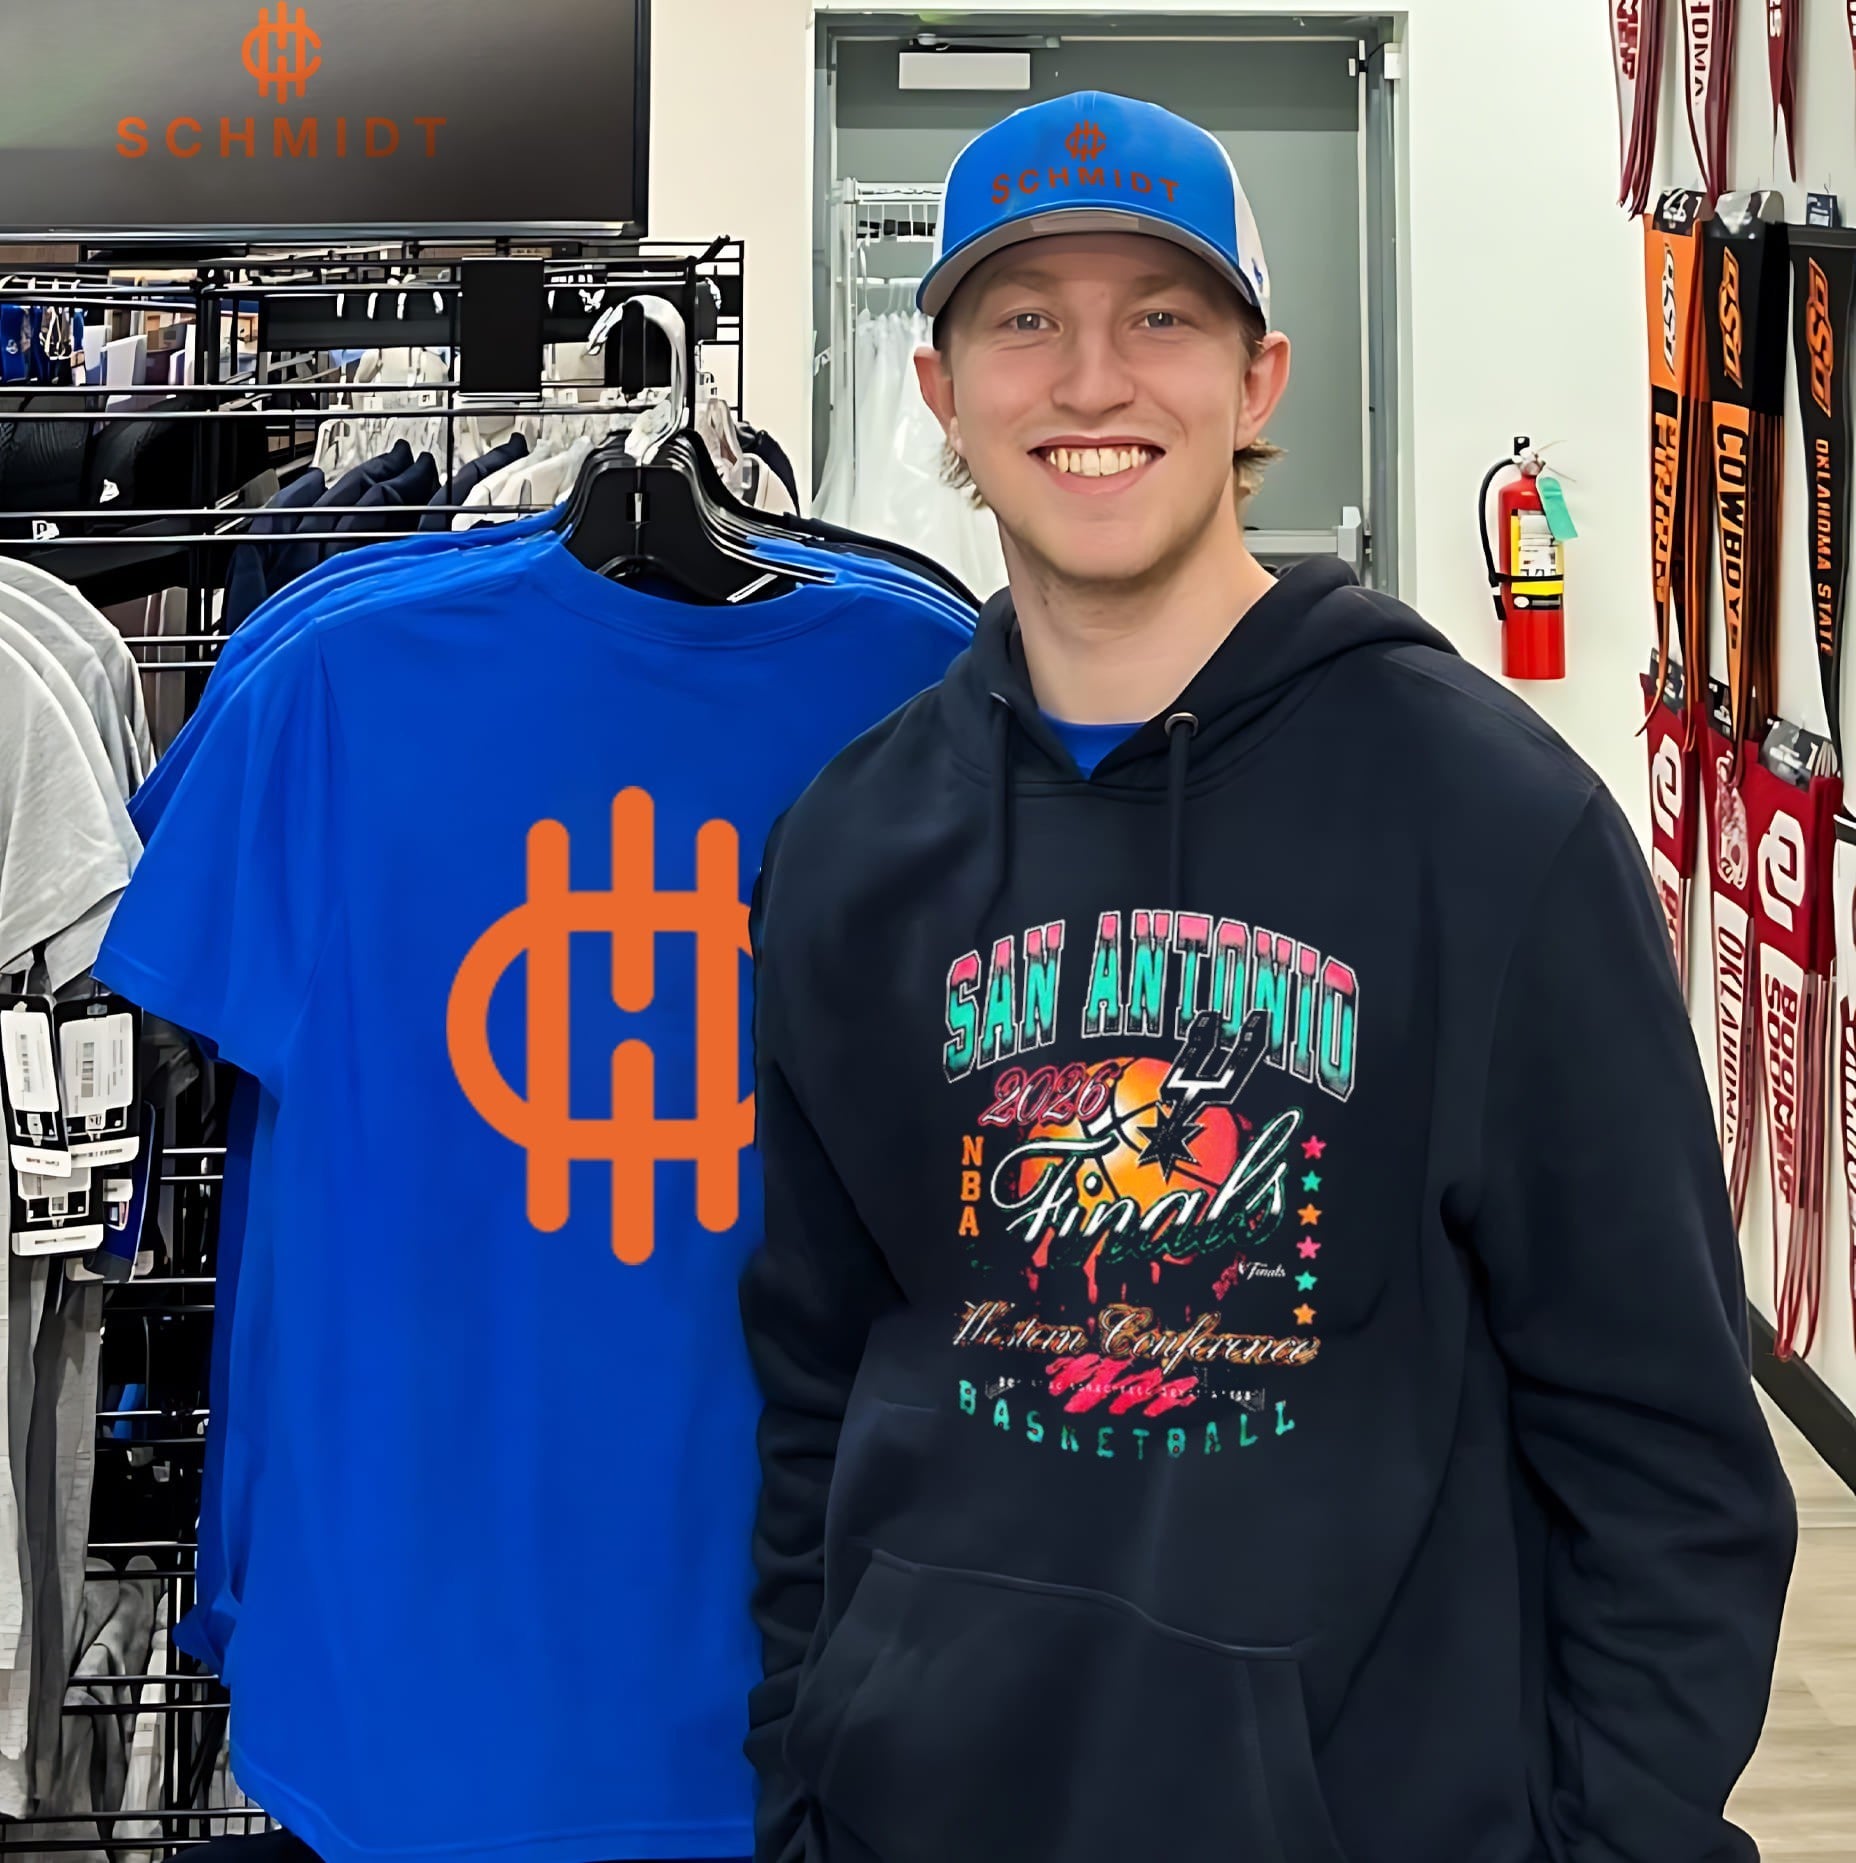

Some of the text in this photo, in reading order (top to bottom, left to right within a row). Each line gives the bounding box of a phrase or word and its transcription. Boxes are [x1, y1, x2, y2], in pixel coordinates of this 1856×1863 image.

[115, 116, 448, 159] SCHMIDT
[991, 167, 1179, 205] SCHMIDT
[1815, 438, 1832, 571] OKLAHOMA
[942, 908, 1360, 1103] SAN ANTONIO
[978, 1059, 1122, 1127] 2026
[958, 1134, 985, 1238] NBA
[990, 1107, 1302, 1243] Finals
[1099, 1303, 1321, 1376] Conference
[959, 1379, 1295, 1461] BASKETBALL
